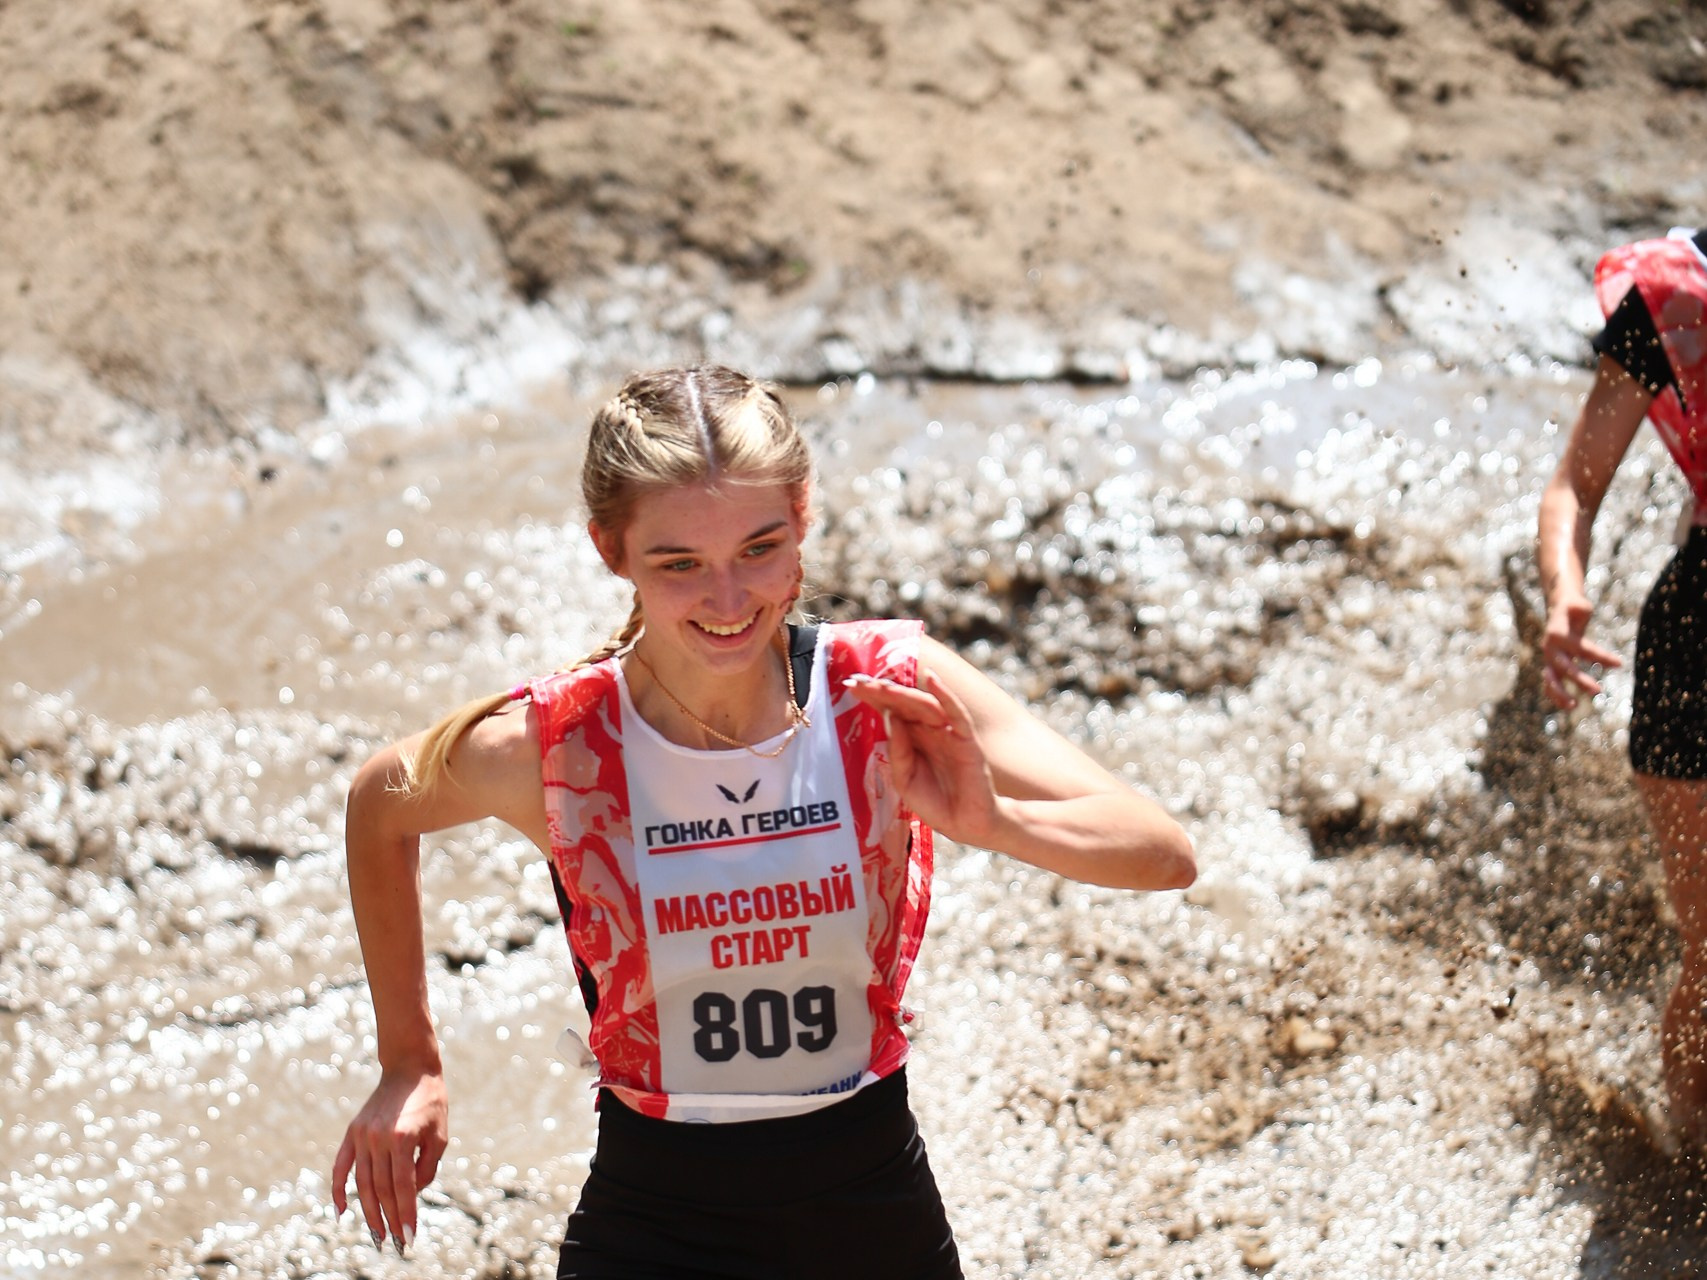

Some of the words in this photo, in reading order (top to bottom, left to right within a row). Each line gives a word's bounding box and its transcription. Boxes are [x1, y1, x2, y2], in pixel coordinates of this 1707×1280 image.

[645, 817, 735, 847] ГОНКА
[742, 801, 840, 835] ГЕРОЕВ
[654, 864, 856, 935] МАССОВЫЙ
[711, 926, 811, 969] СТАРТ
[693, 985, 838, 1063] 809
